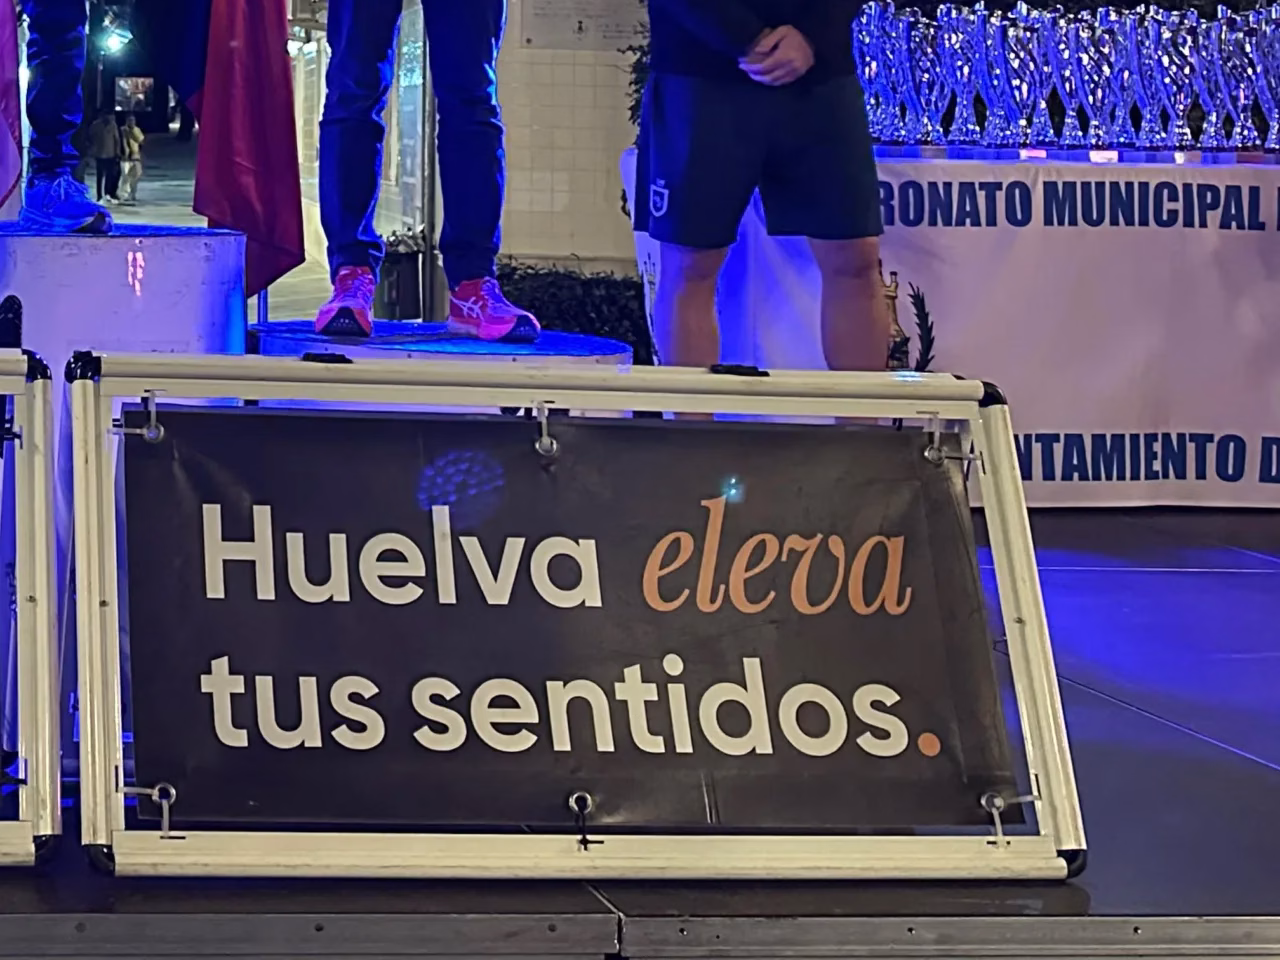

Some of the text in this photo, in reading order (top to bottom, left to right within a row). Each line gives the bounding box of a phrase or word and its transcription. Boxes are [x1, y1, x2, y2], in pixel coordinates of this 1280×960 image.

[1042, 180, 1266, 232] MUNICIPAL
[202, 495, 912, 617] Huelva eleva
[200, 652, 942, 758] tus sentidos.
